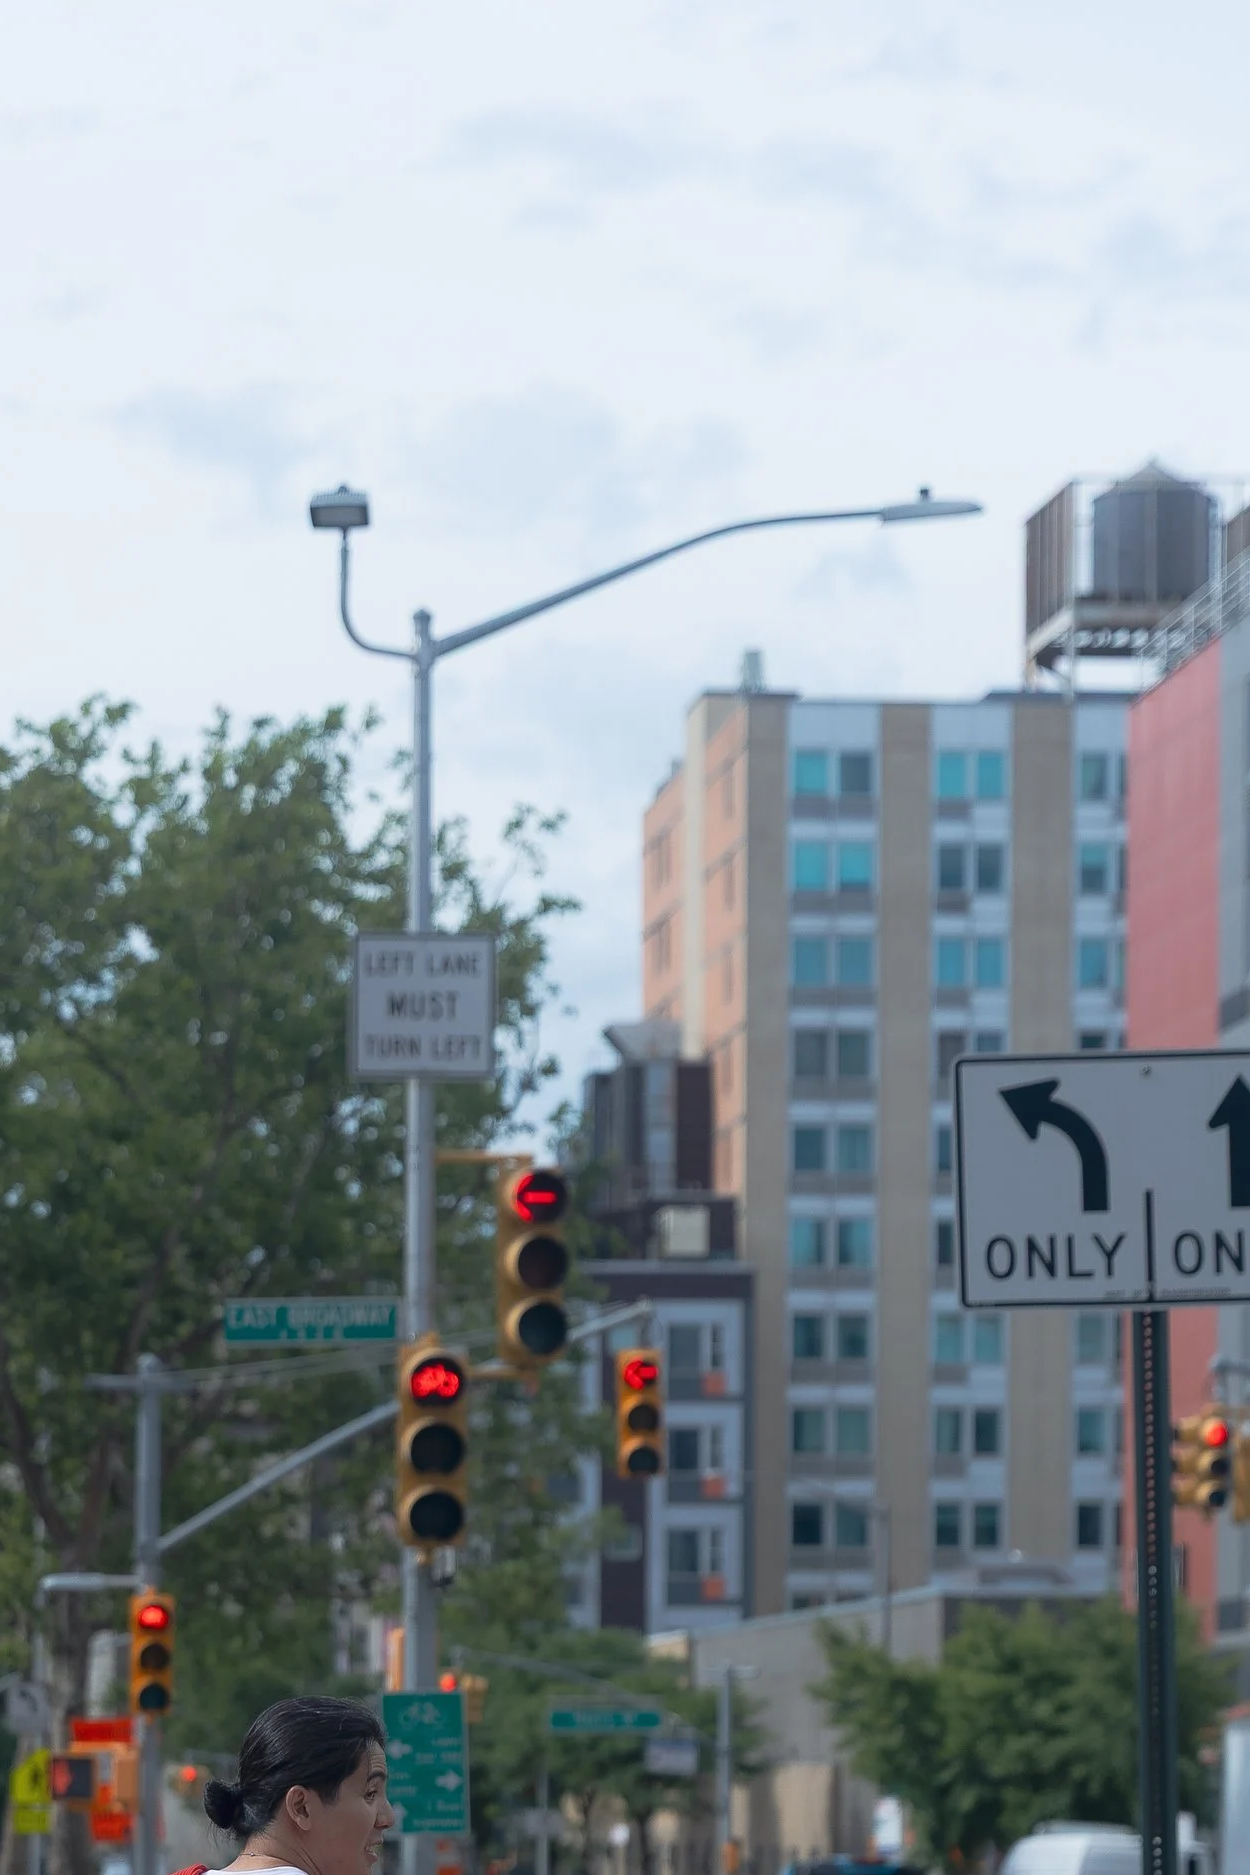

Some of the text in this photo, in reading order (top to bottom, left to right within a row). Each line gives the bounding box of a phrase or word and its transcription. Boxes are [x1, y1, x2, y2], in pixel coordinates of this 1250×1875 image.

[363, 952, 480, 977] LEFT LANE
[388, 991, 459, 1020] MUST
[364, 1035, 481, 1060] TURN LEFT
[986, 1232, 1126, 1279] ONLY
[1174, 1229, 1244, 1275] ON
[227, 1305, 276, 1328] EAST
